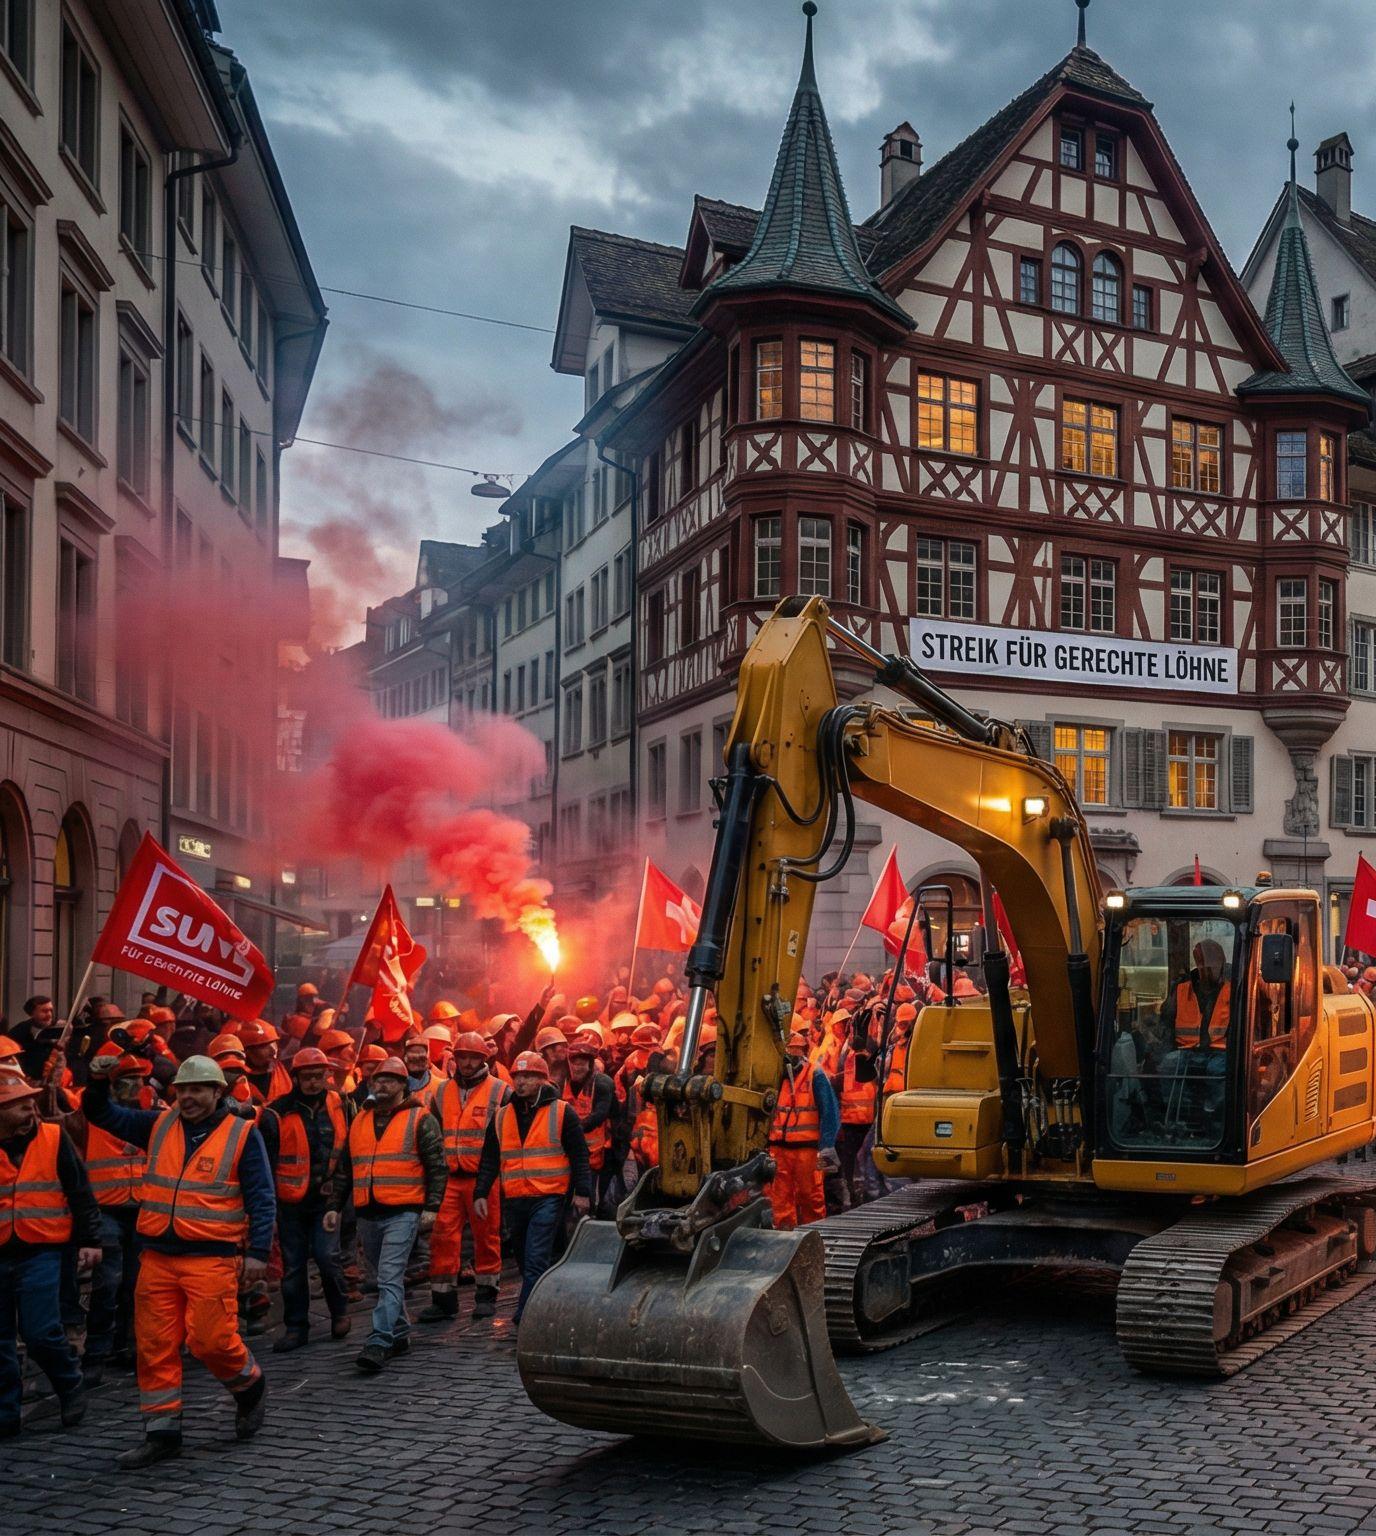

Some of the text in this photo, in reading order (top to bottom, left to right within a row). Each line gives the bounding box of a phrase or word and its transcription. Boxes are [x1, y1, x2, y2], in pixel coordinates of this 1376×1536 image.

[921, 632, 1229, 683] STREIK FÜR GERECHTE LÖHNE
